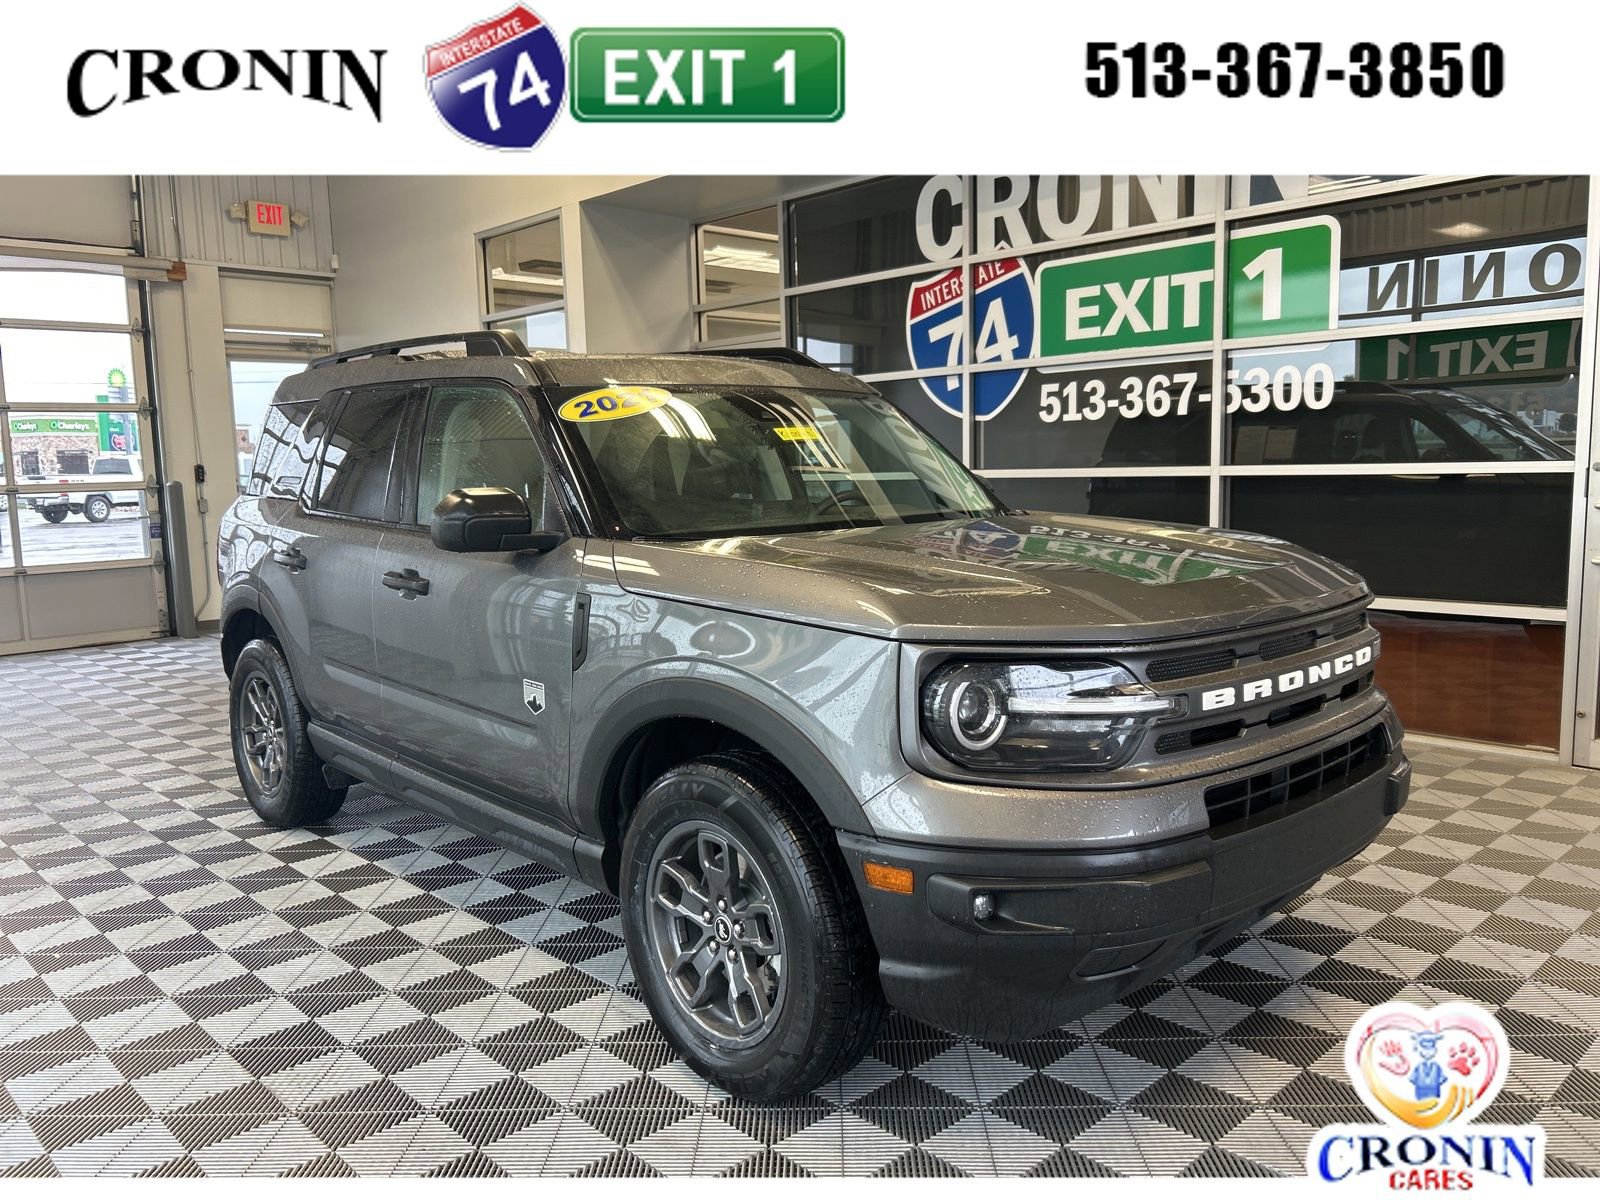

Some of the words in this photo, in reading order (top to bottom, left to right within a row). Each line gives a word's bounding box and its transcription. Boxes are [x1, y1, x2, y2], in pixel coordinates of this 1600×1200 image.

[256, 203, 283, 226] EXIT
[920, 259, 1006, 312] INTERATE
[1065, 269, 1214, 340] EXIT
[1242, 247, 1283, 320] 1
[928, 297, 1020, 391] 74
[1038, 362, 1335, 423] 513-367-5300
[1202, 645, 1372, 711] BRONCO
